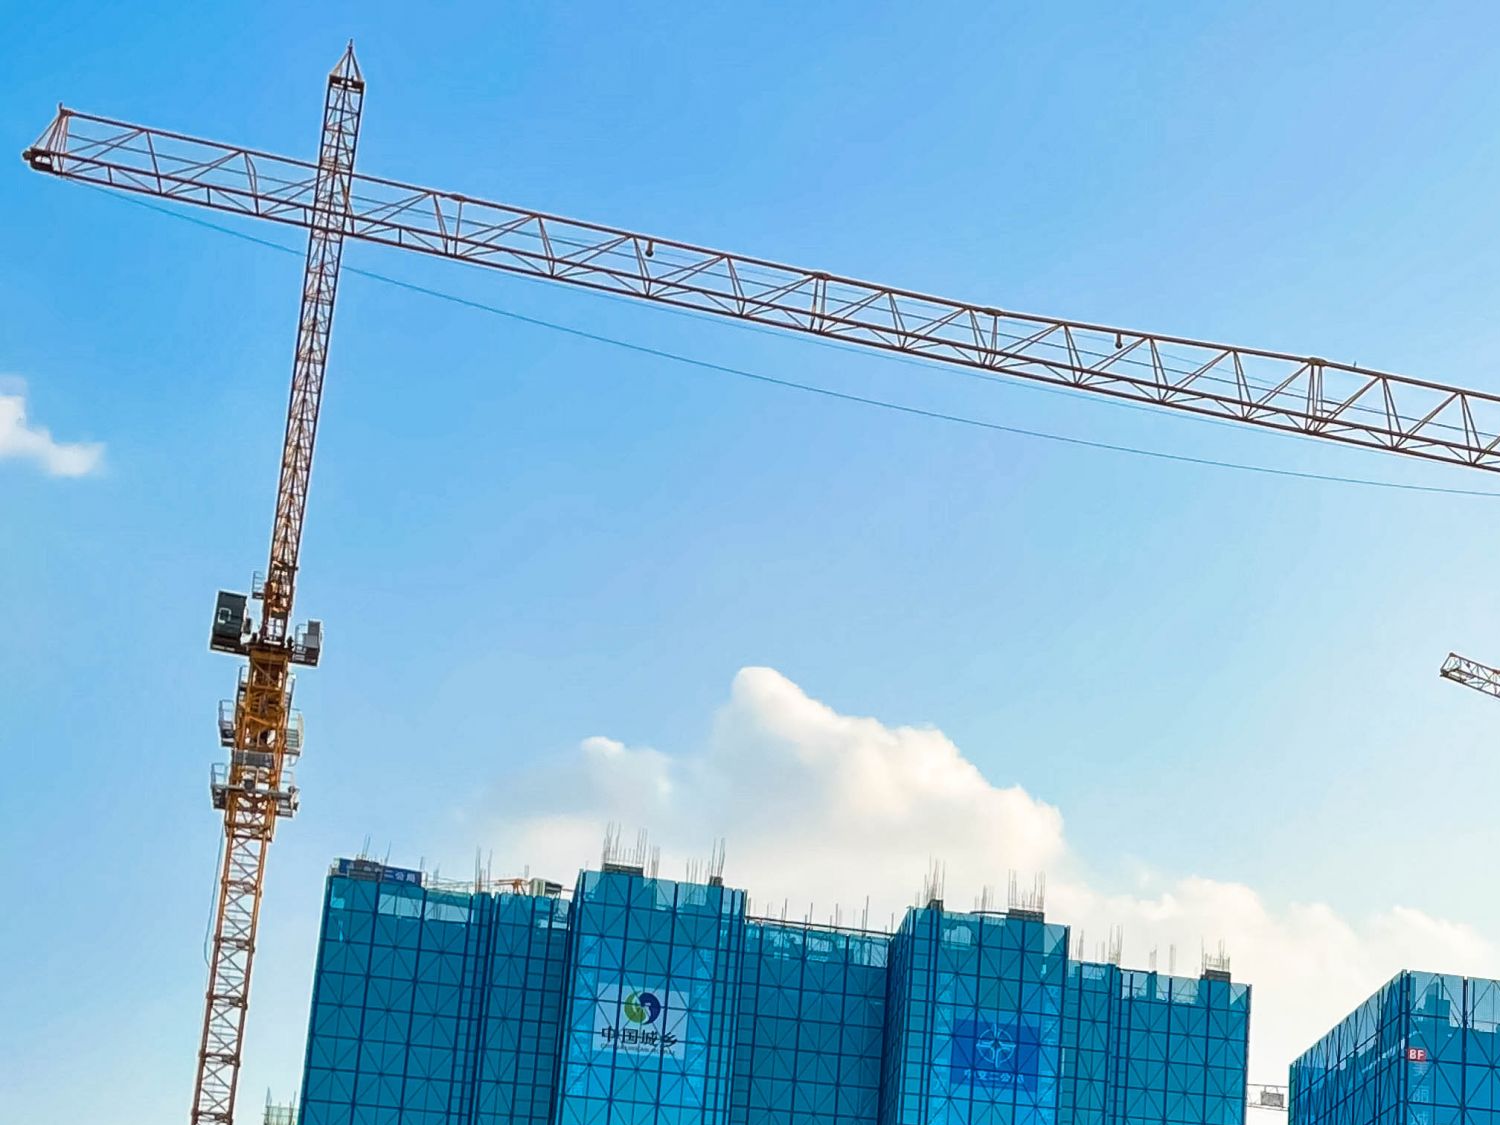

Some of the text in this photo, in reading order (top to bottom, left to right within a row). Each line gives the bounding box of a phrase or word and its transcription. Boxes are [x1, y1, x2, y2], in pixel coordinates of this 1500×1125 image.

[602, 1025, 678, 1047] 中国城乡
[1409, 1049, 1425, 1060] 8F
